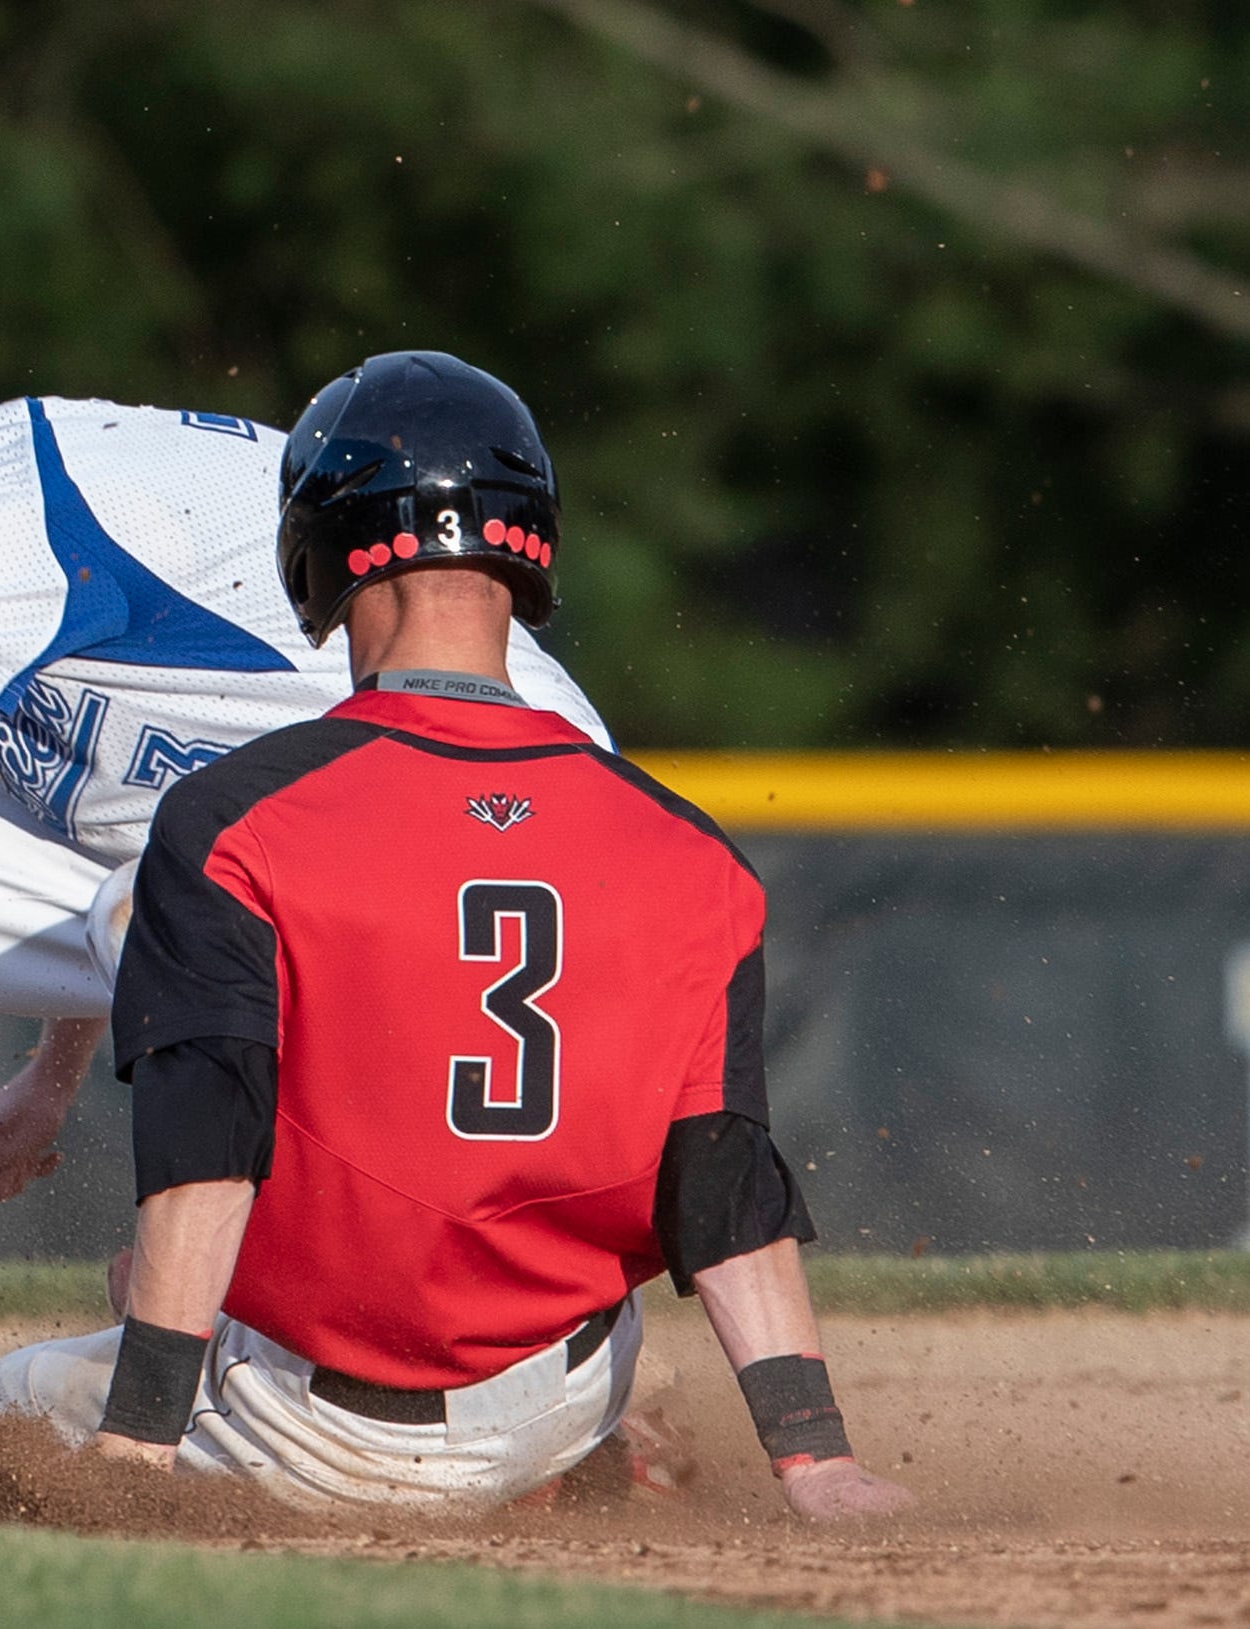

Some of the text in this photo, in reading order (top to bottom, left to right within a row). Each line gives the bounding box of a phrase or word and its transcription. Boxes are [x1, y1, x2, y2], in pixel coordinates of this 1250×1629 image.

[436, 509, 462, 552] 3
[402, 678, 440, 691] NIKE
[444, 680, 477, 694] PRO
[446, 878, 564, 1142] 3
